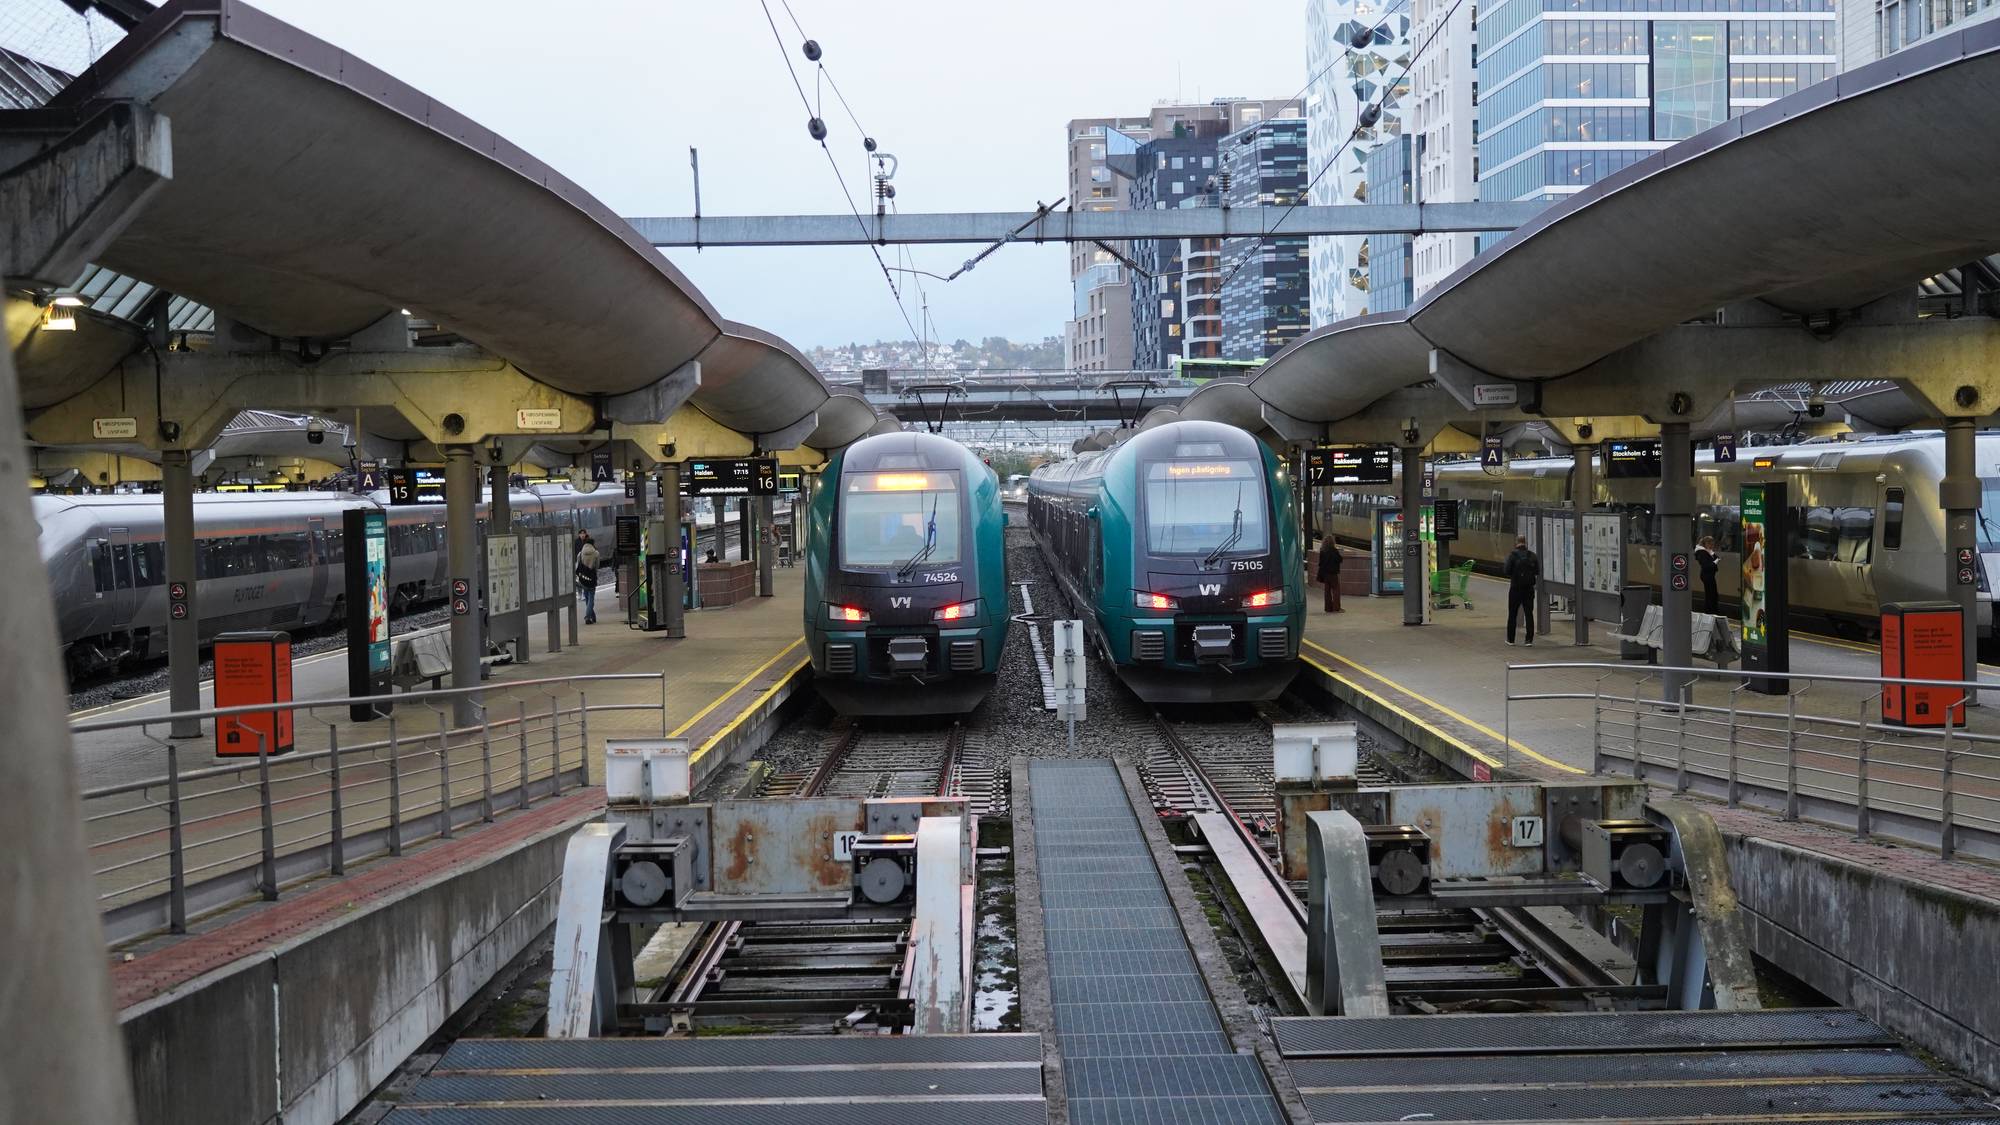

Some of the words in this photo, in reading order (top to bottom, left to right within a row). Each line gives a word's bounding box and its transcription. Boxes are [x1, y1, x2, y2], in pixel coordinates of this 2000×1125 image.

[1487, 449, 1498, 462] A
[1721, 446, 1731, 459] A
[597, 465, 607, 478] A
[1309, 467, 1325, 480] 17
[363, 474, 374, 487] A
[758, 477, 774, 489] 16
[1425, 479, 1431, 488] B
[393, 486, 408, 499] 15
[628, 488, 635, 497] B
[1231, 561, 1264, 571] 75105
[924, 572, 958, 583] 74526
[1519, 820, 1535, 839] 17
